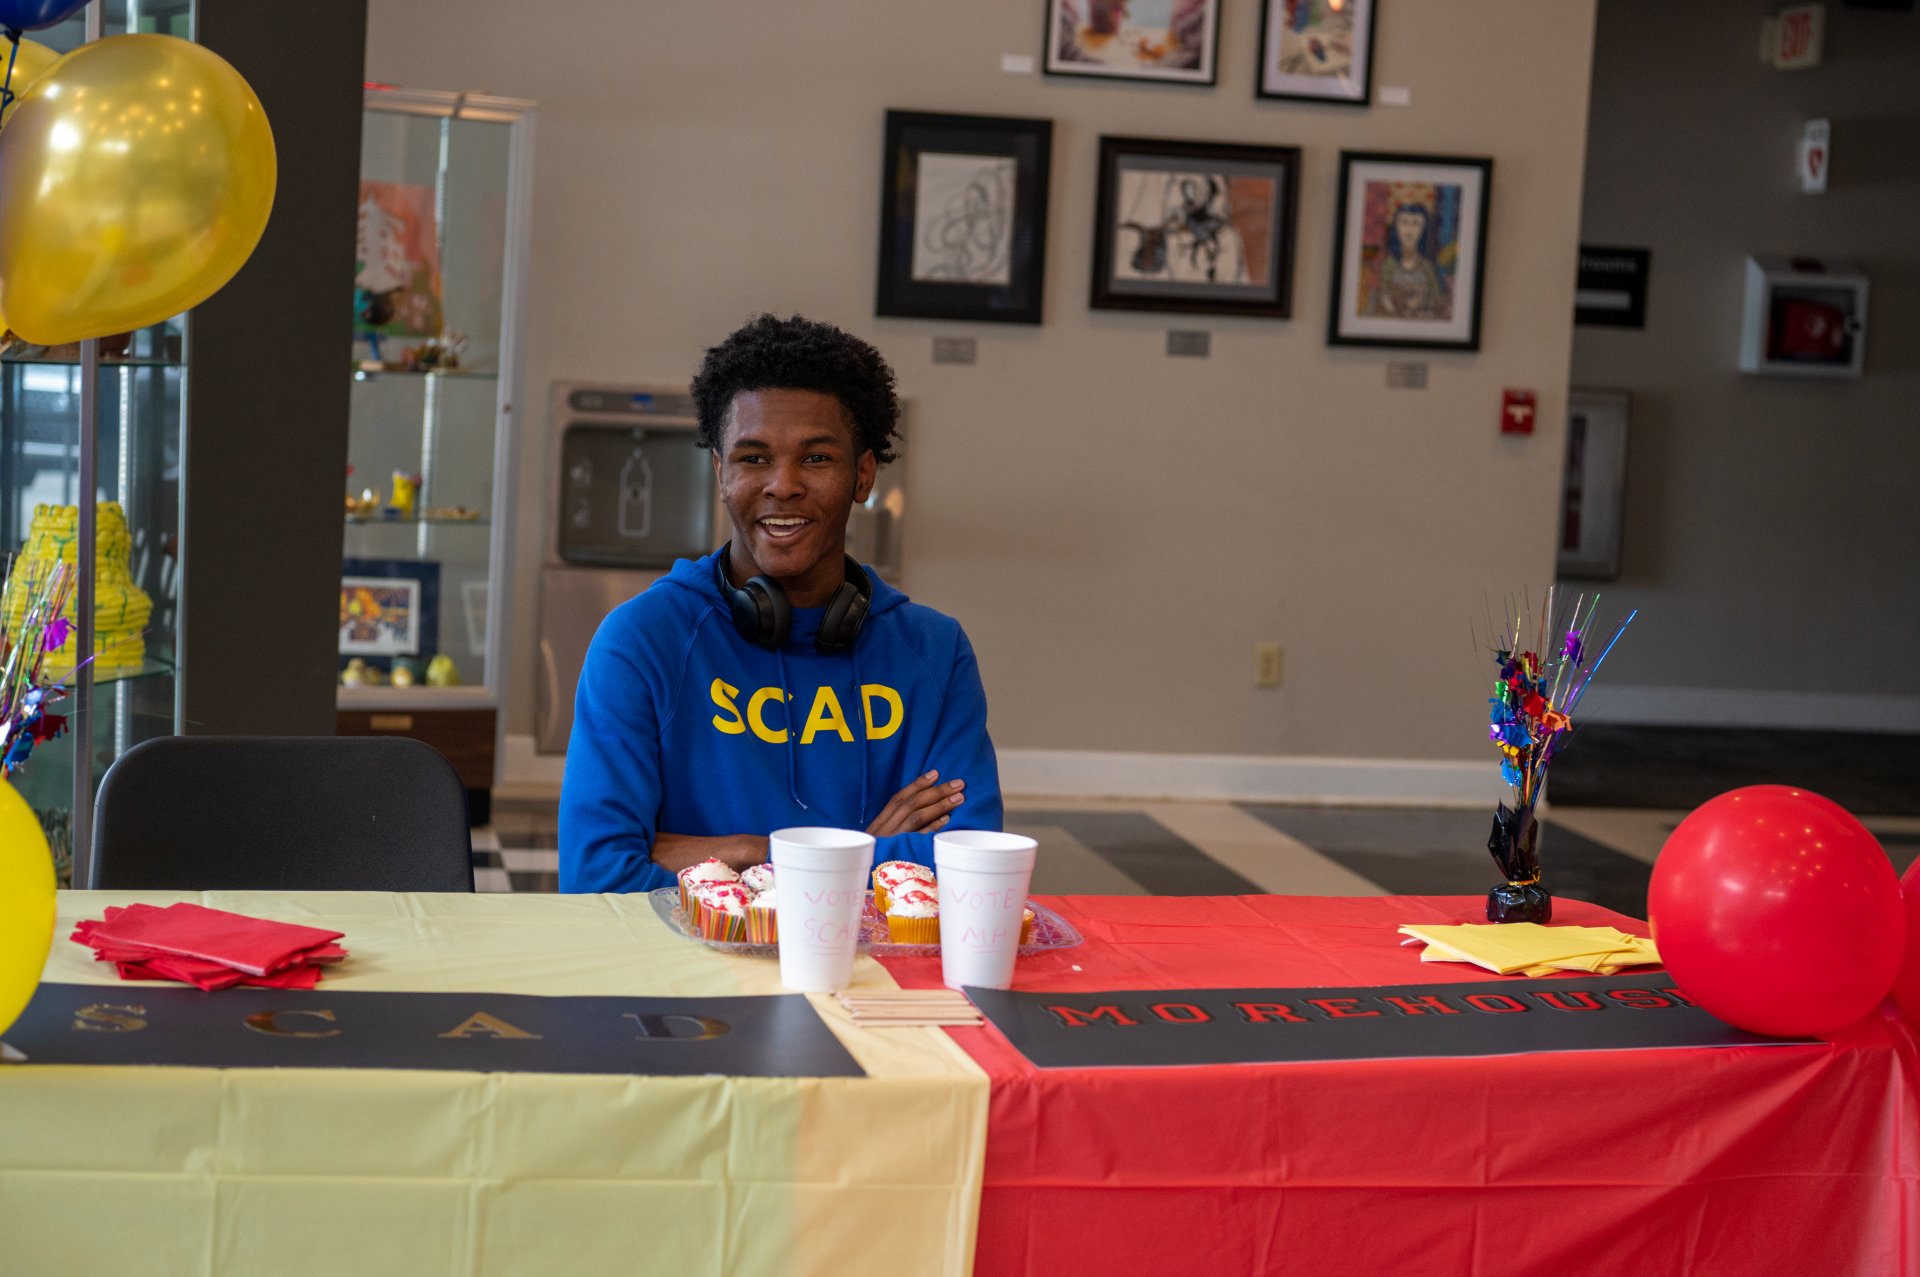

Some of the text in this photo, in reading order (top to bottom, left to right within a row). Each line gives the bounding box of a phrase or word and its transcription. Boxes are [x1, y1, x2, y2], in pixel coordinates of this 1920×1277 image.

[710, 677, 904, 744] SCAD
[804, 889, 861, 907] VOTE
[950, 887, 1016, 910] VOTE
[962, 926, 1010, 944] MH
